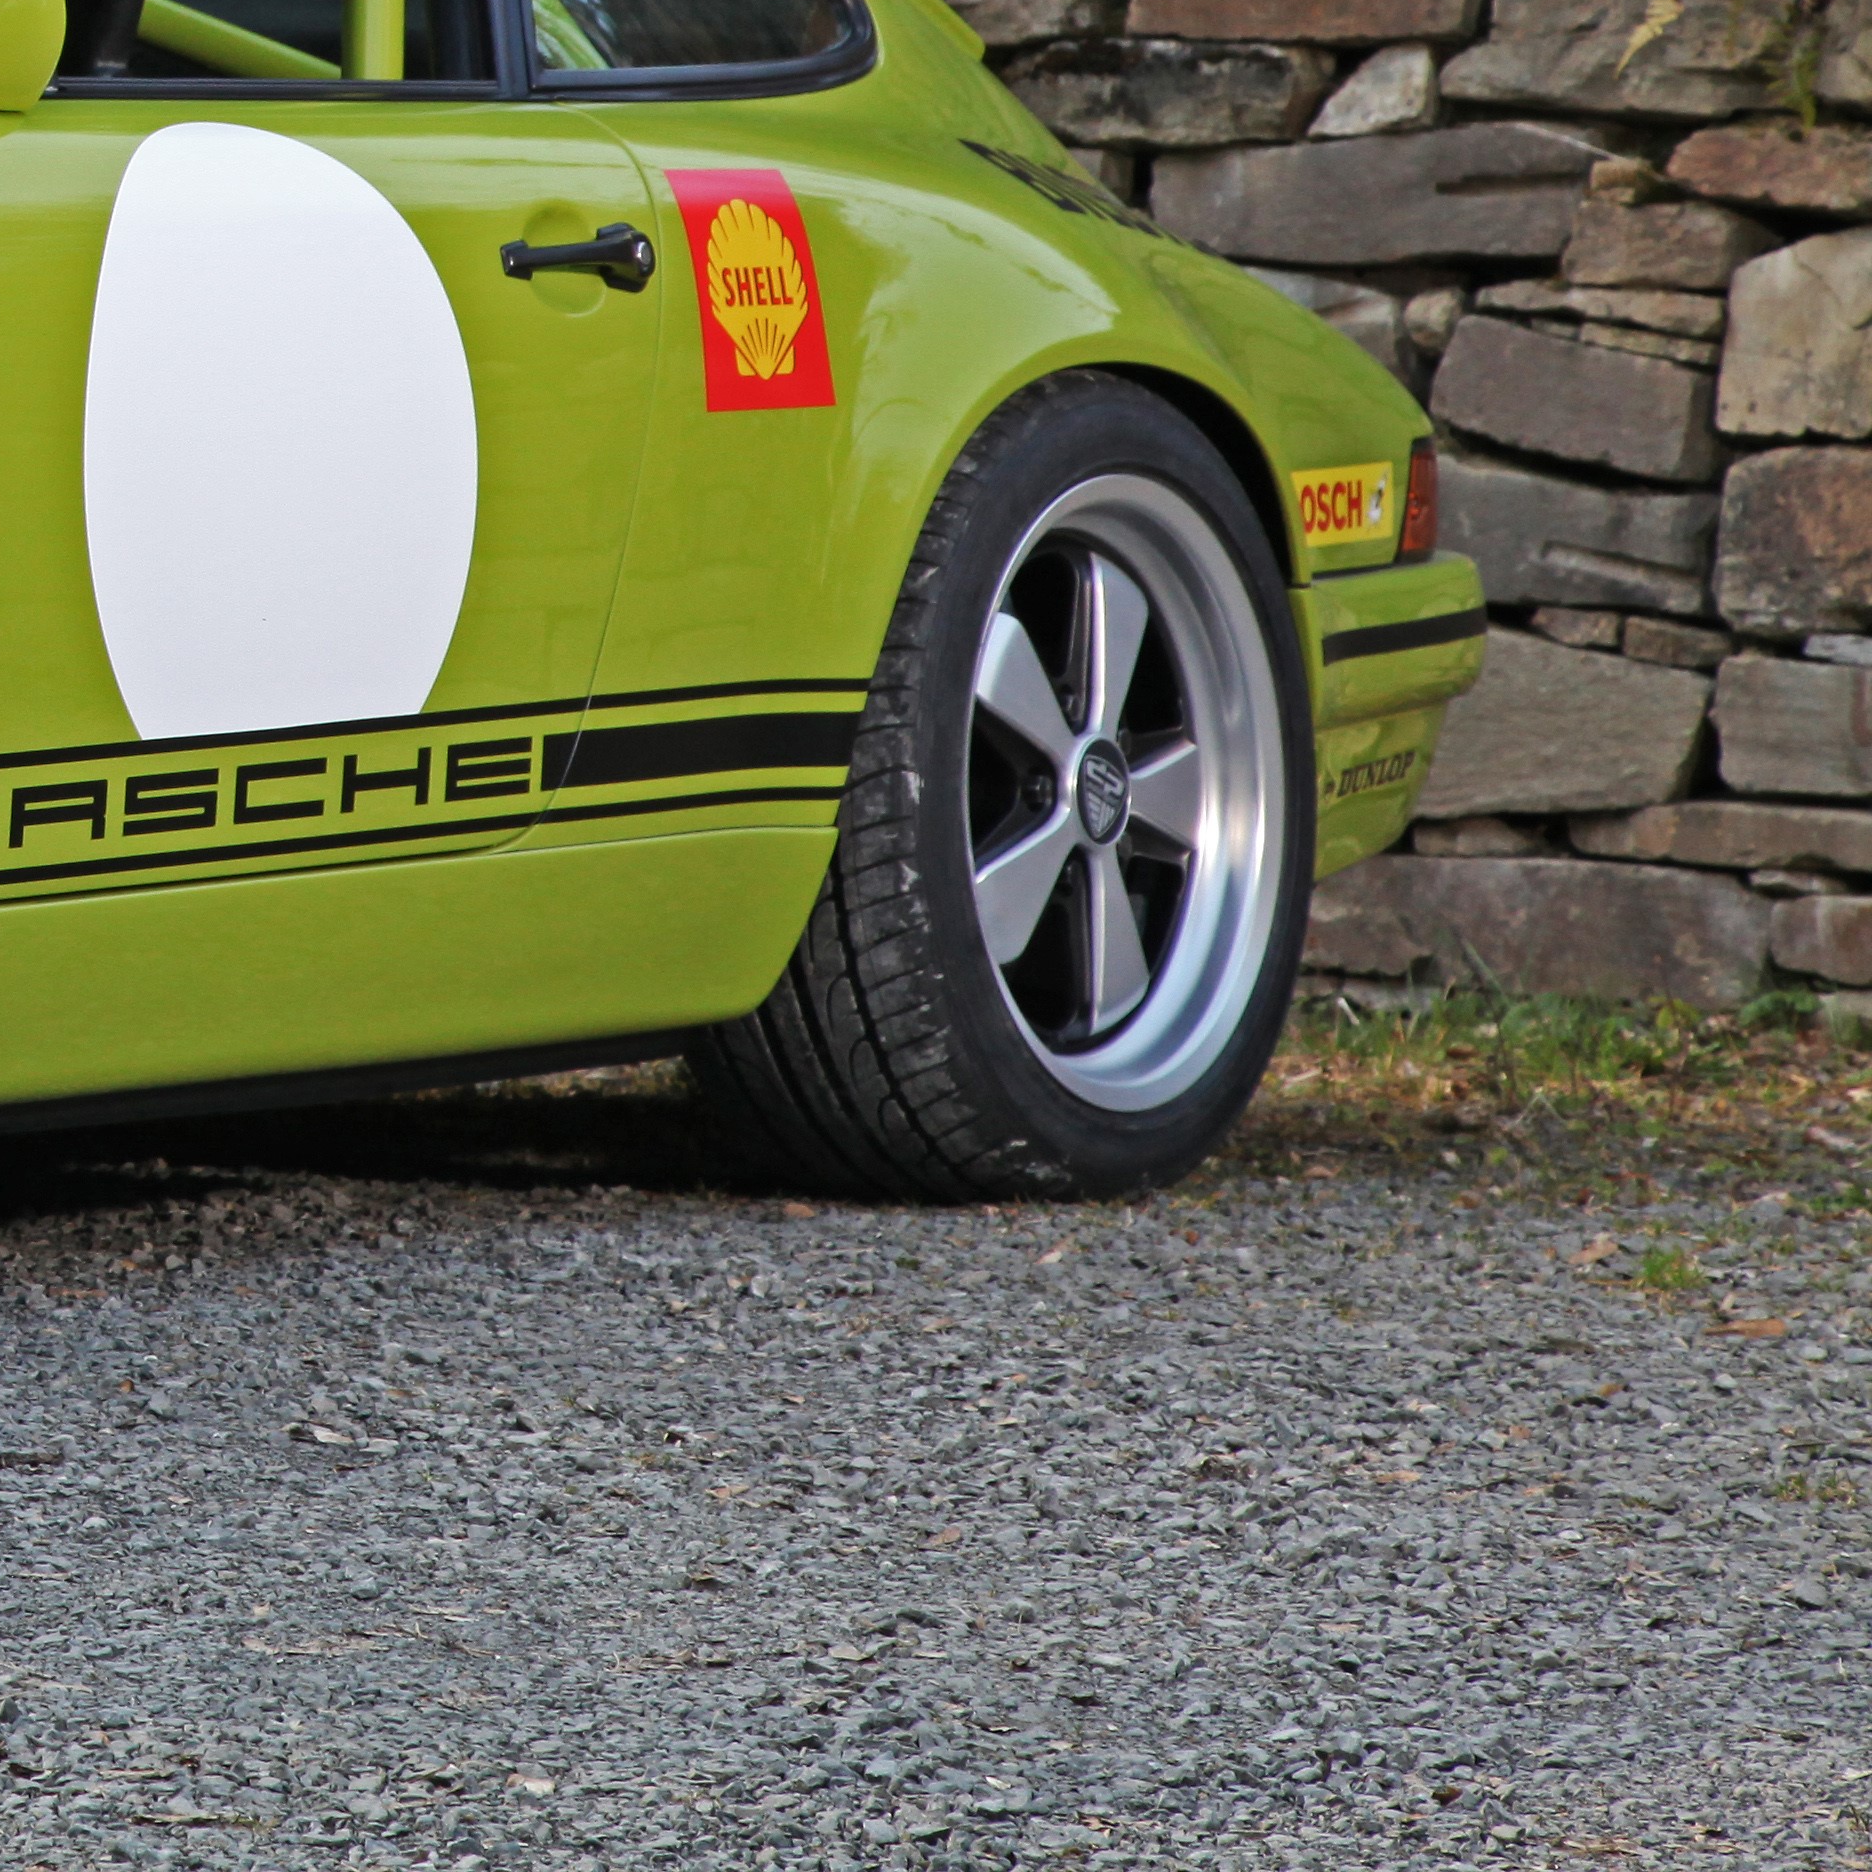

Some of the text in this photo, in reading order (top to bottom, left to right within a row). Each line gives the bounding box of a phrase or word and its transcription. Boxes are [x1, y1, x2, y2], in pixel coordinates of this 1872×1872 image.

[721, 265, 795, 307] SHELL
[1300, 479, 1364, 534] OSCH
[1336, 751, 1415, 797] DUNLOP
